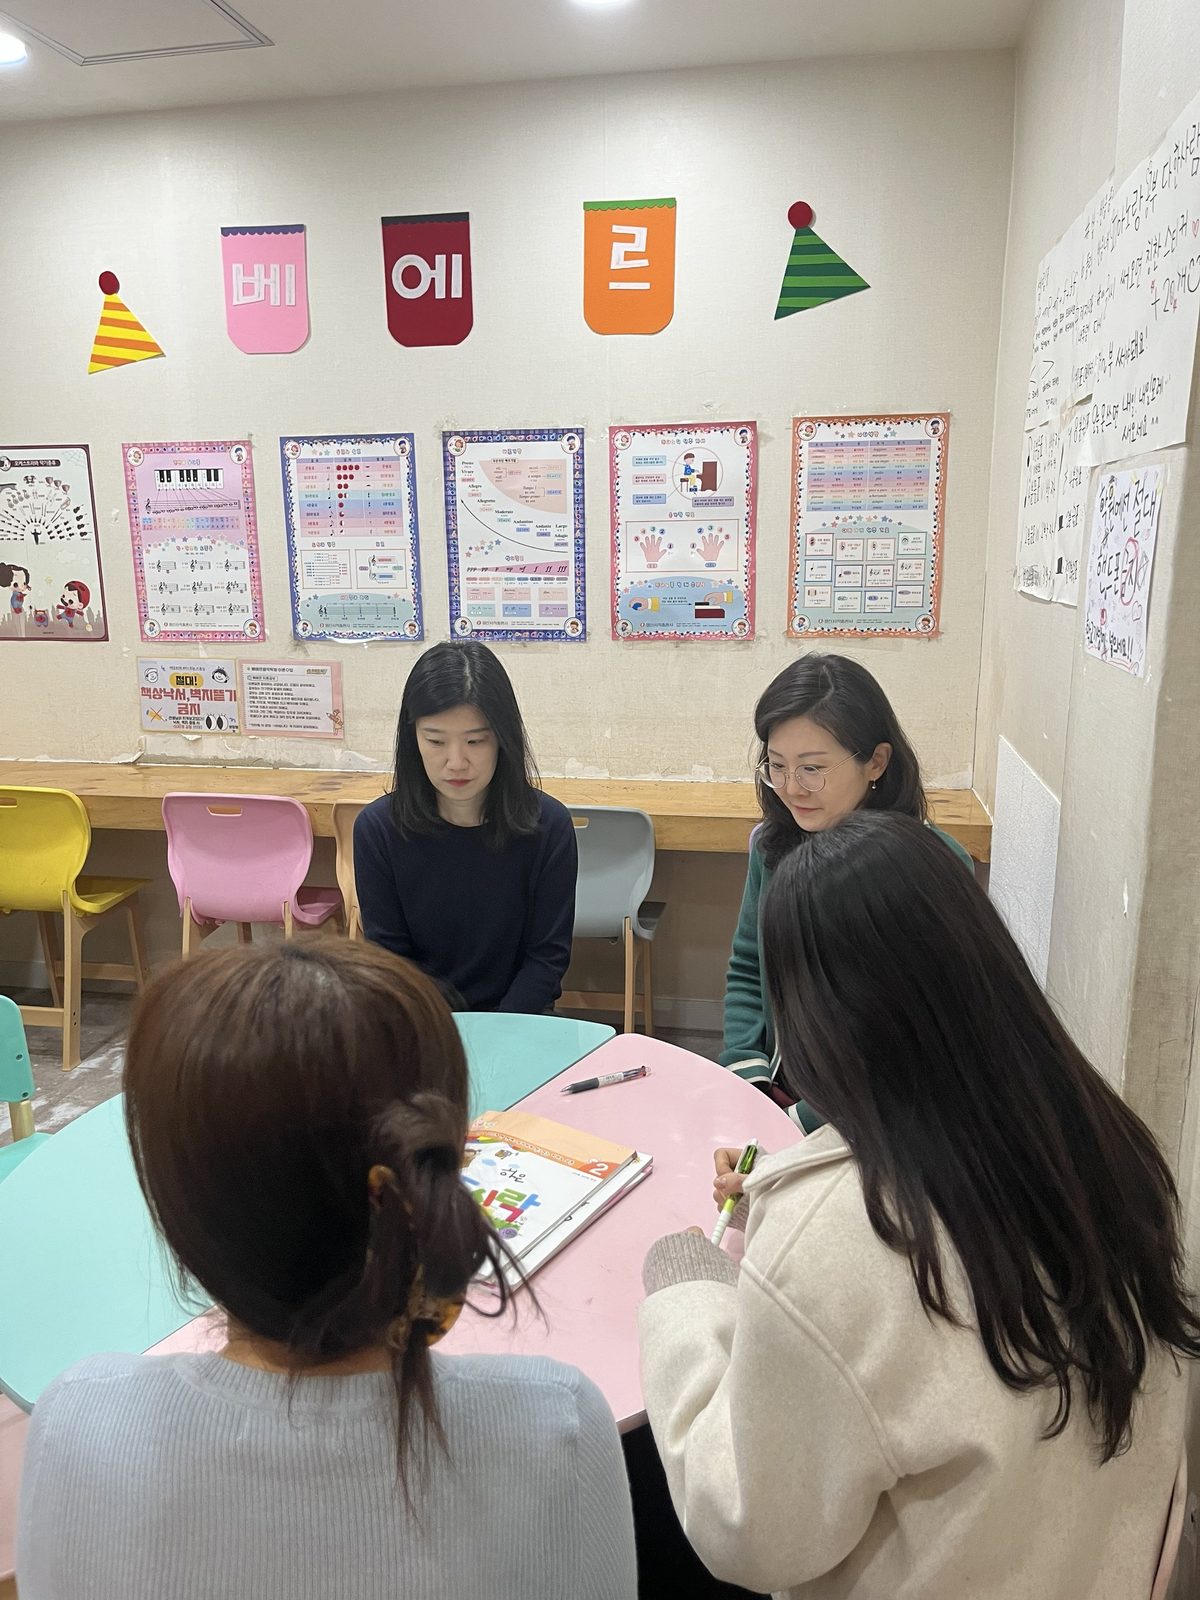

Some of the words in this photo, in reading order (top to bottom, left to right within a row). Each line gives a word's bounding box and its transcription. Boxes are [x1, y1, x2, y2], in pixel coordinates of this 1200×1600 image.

[232, 262, 297, 307] 베
[391, 253, 463, 301] 에
[609, 224, 651, 290] 르
[1132, 478, 1157, 538] 절대
[175, 675, 197, 686] 절대!
[177, 703, 201, 716] 금지
[591, 1161, 609, 1177] 2
